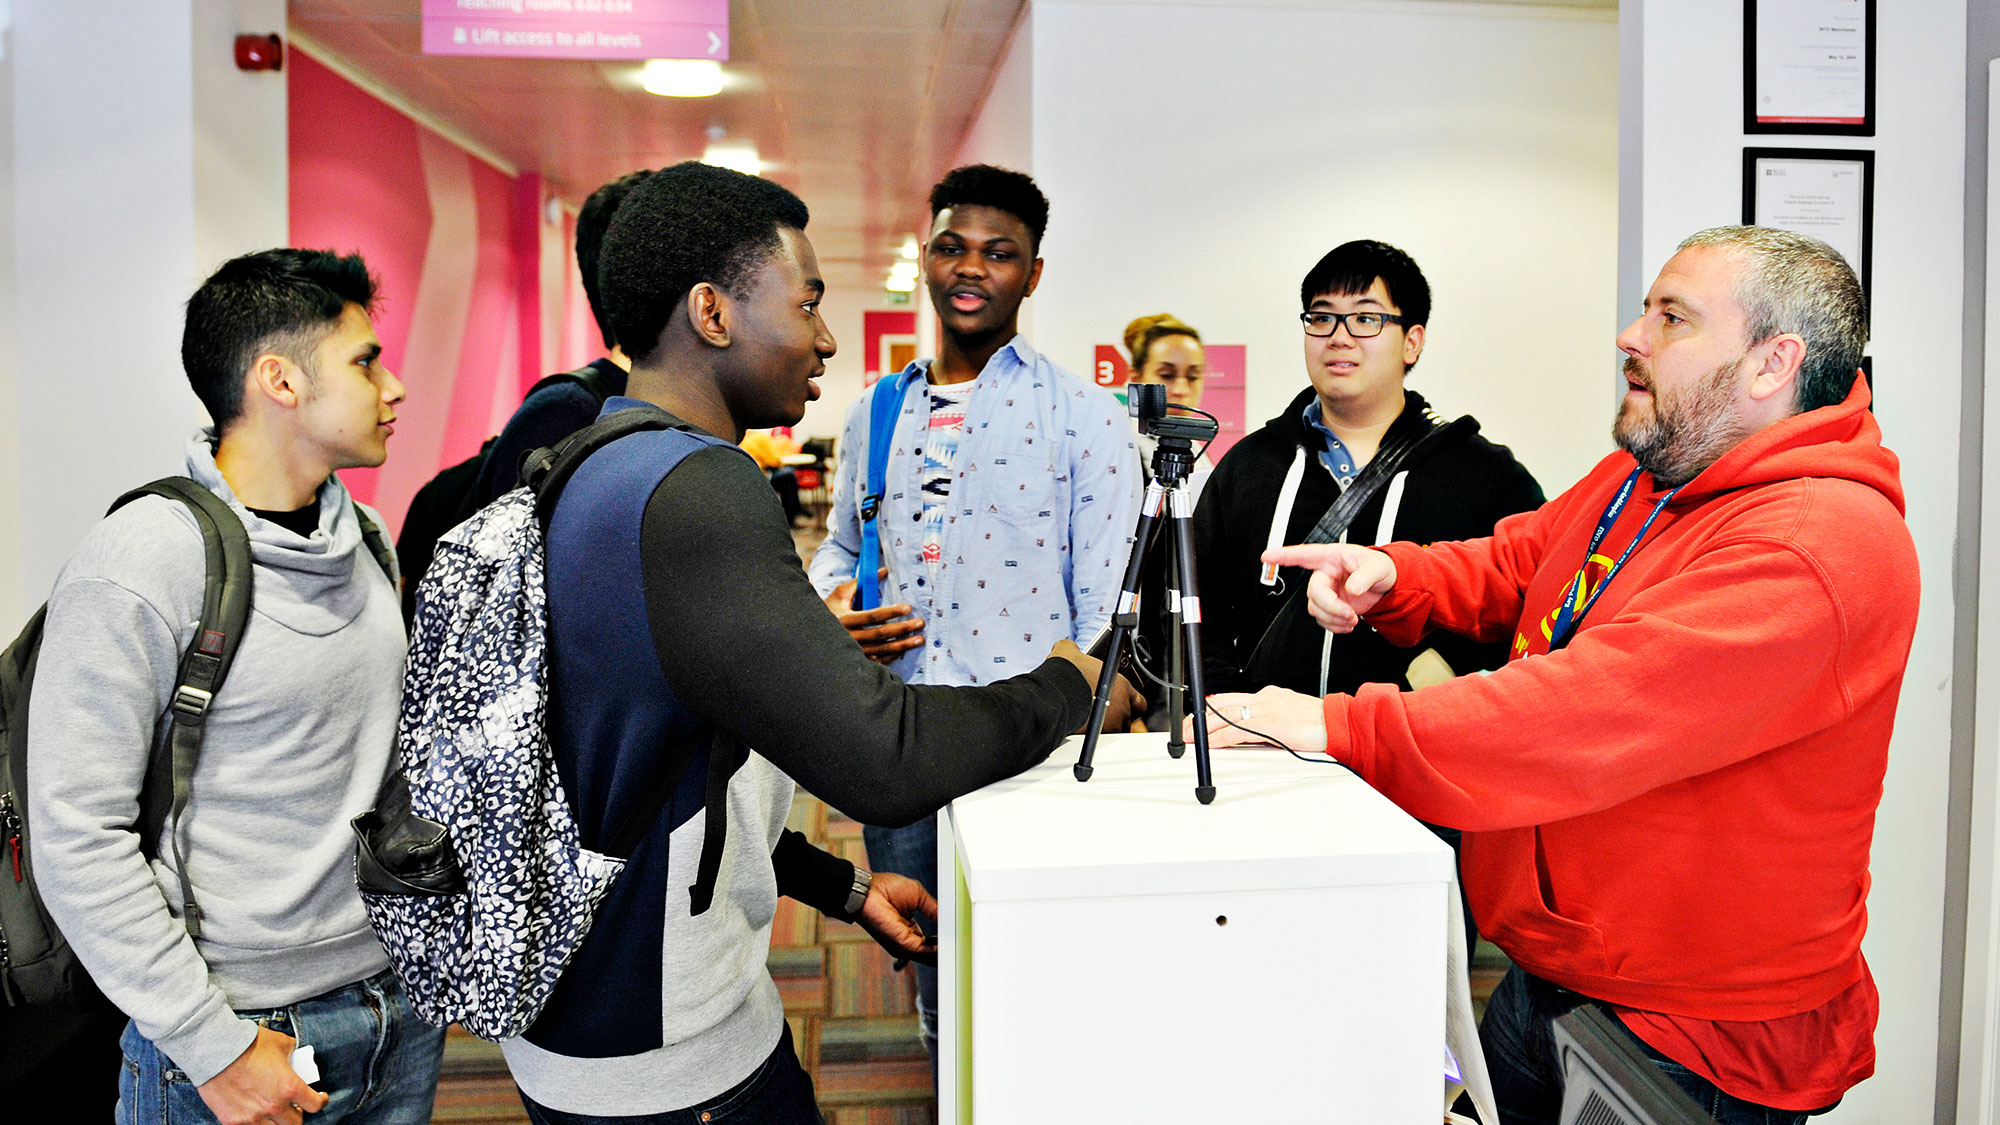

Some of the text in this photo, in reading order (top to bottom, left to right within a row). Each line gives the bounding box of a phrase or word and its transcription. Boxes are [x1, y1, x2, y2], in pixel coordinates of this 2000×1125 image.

[471, 28, 643, 48] Lift access to all levels
[1098, 361, 1115, 384] 3
